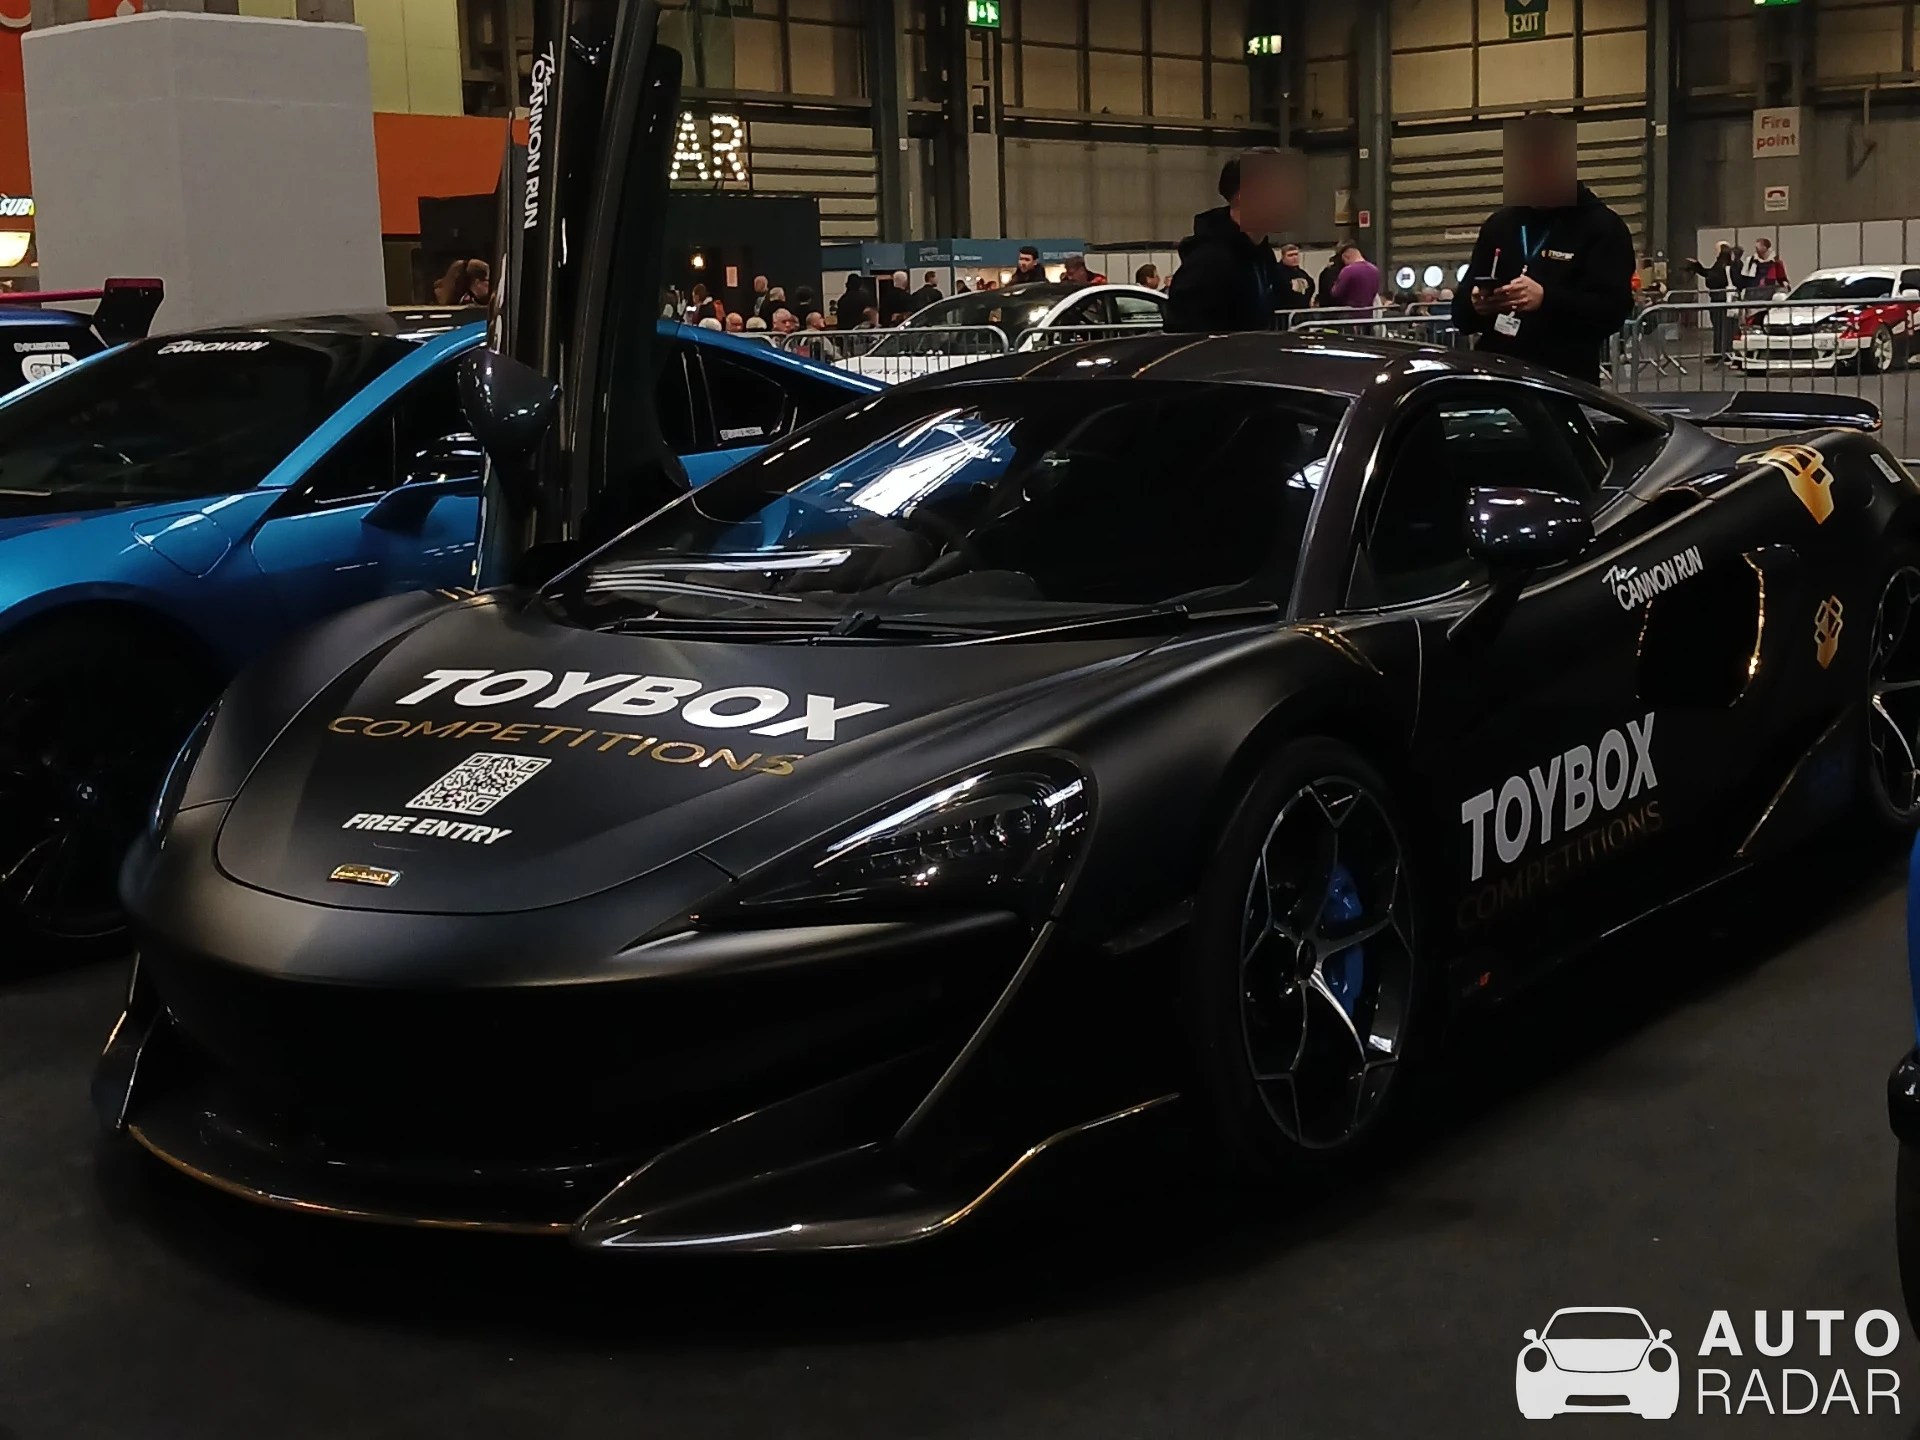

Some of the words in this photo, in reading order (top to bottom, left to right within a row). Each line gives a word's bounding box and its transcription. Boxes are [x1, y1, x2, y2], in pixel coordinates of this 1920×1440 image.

[1513, 12, 1540, 33] EXIT
[527, 59, 546, 173] CANNON
[669, 111, 746, 180] AR
[1757, 133, 1796, 151] point
[1761, 116, 1791, 129] Fire
[524, 176, 540, 229] RUN
[1602, 565, 1638, 596] The
[1617, 560, 1678, 611] CANNON
[1673, 545, 1703, 580] RUN
[396, 669, 890, 741] TOYBOX
[327, 716, 805, 776] COMPETITIONS
[1461, 711, 1658, 882] TOYBOX
[342, 813, 417, 832] FREE
[409, 818, 513, 844] ENTRY
[1456, 800, 1664, 930] COMPETITIONS
